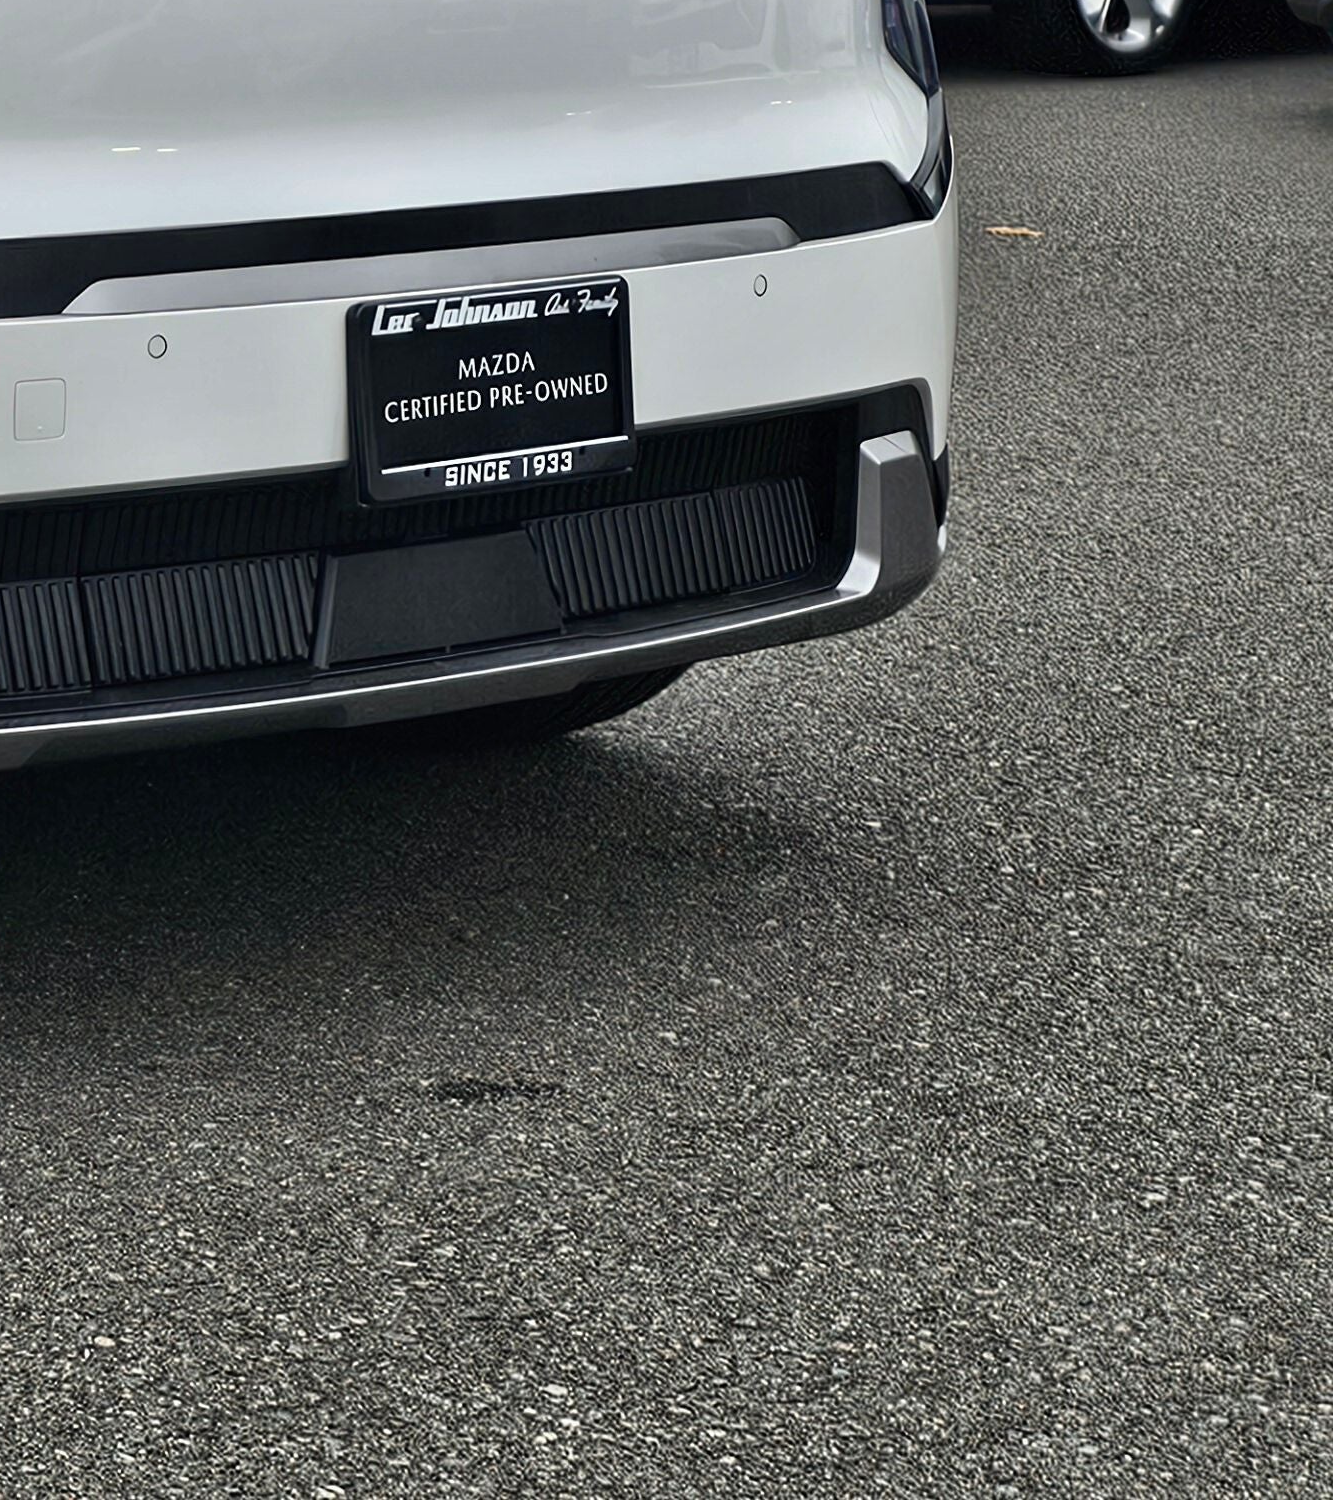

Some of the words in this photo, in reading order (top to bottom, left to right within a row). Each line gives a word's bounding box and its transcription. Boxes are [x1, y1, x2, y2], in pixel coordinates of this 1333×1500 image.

[371, 304, 420, 336] Lee
[426, 296, 538, 331] Johnson
[458, 351, 536, 380] MAZDA
[384, 390, 482, 423] CERTIFIED
[489, 372, 608, 409] PRE-OWNED
[444, 459, 511, 487] SINCE
[523, 451, 573, 477] 1933
